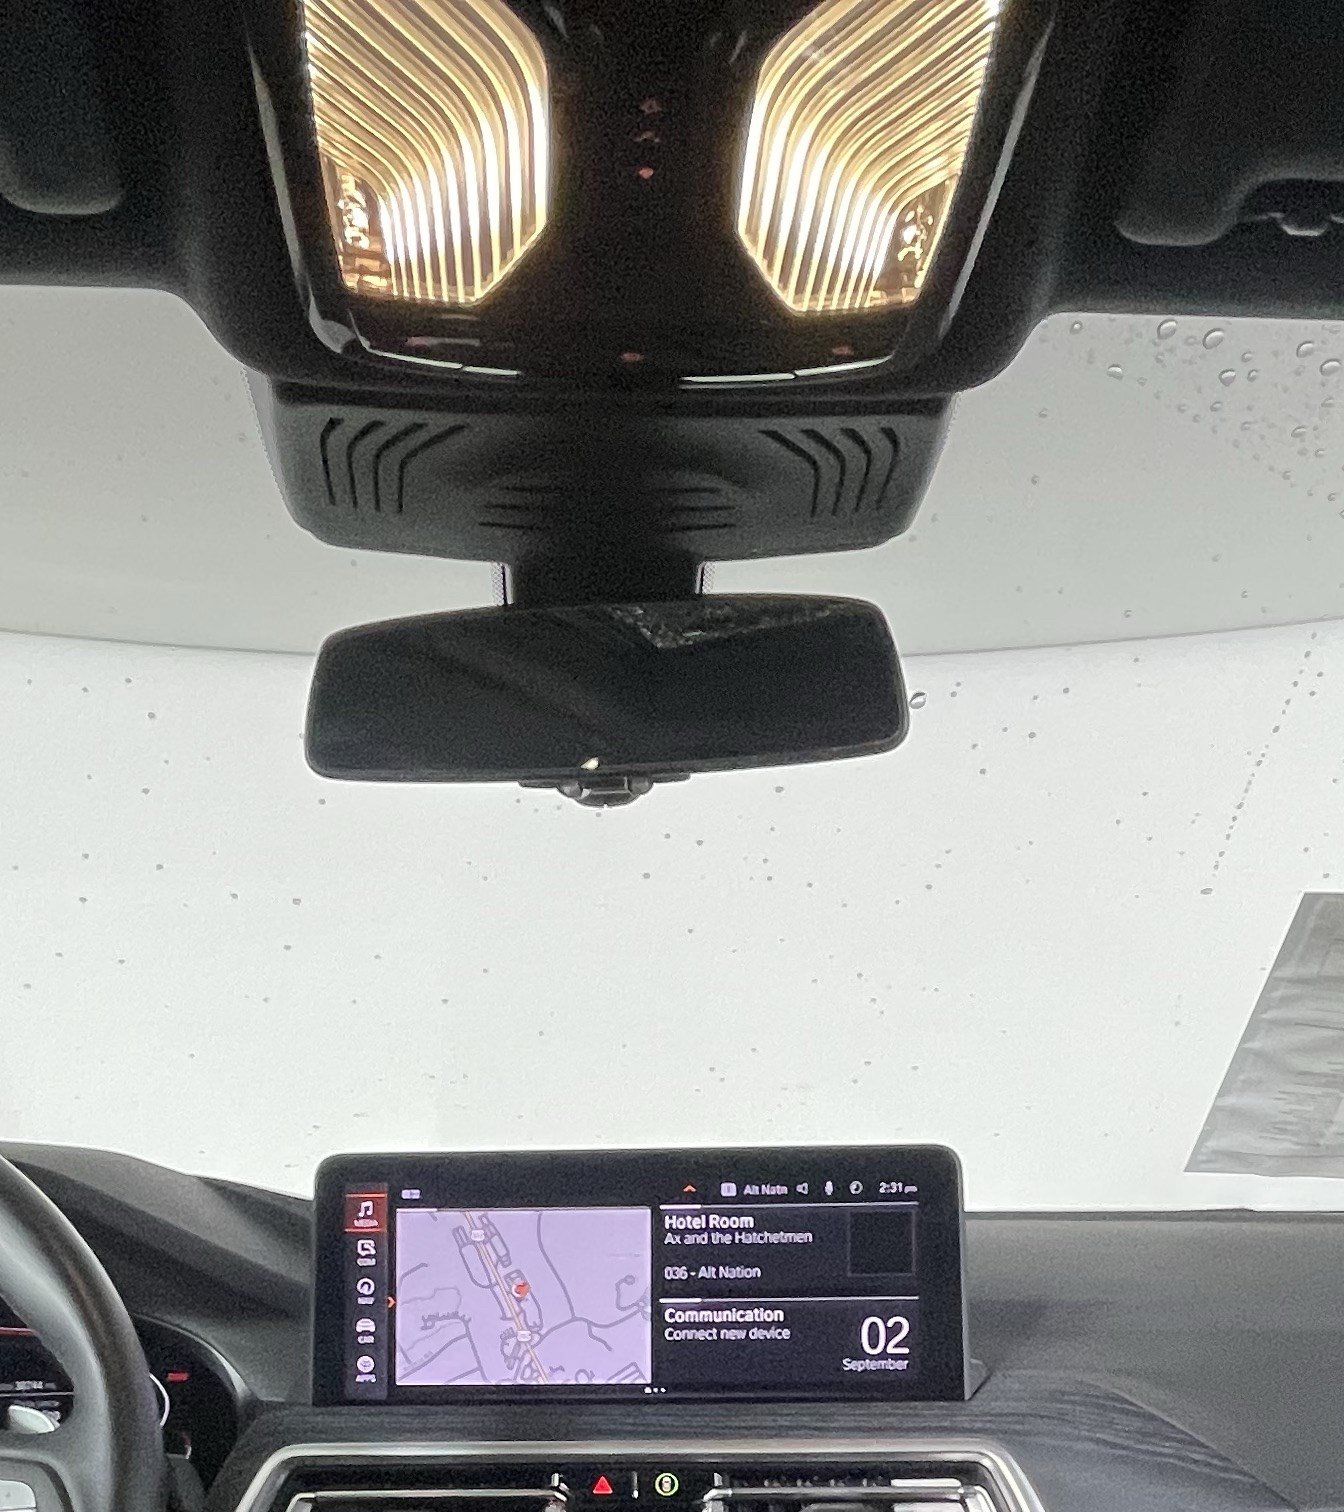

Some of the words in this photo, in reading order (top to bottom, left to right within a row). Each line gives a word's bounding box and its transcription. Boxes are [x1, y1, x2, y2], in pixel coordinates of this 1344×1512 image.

[879, 1181, 903, 1194] 2:31
[664, 1214, 706, 1229] Hotel
[709, 1214, 754, 1229] Room
[664, 1232, 681, 1245] Ax
[683, 1232, 708, 1245] and
[711, 1232, 732, 1244] the
[734, 1230, 813, 1244] Hatchetmen
[664, 1266, 688, 1280] 036
[698, 1266, 717, 1279] Alt
[718, 1265, 761, 1279] Nation
[664, 1307, 784, 1323] Communication
[664, 1327, 717, 1341] Connect
[720, 1330, 747, 1340] new
[749, 1325, 791, 1340] device
[860, 1316, 910, 1355] 02
[842, 1357, 909, 1372] September
